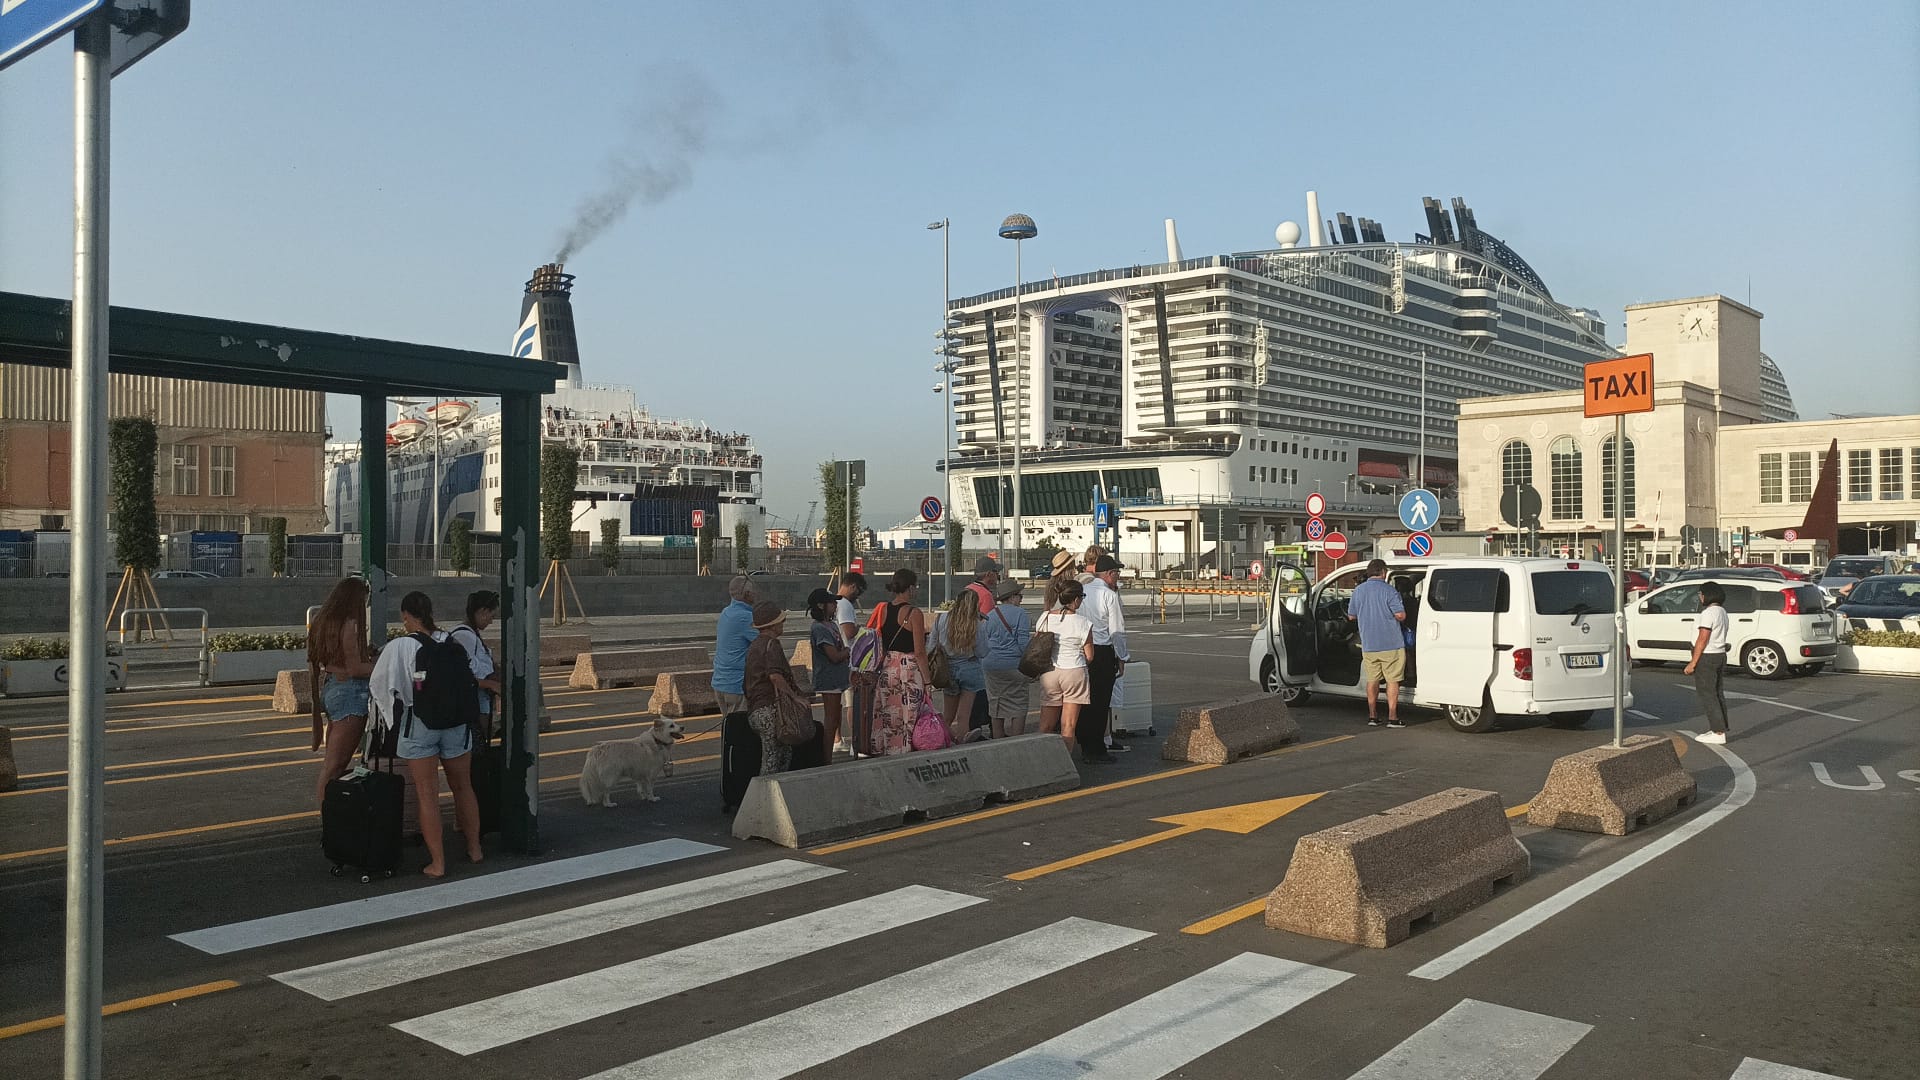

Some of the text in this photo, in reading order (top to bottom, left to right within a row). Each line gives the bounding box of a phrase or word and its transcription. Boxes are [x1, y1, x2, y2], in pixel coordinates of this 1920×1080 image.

[1589, 371, 1647, 401] TAXI
[693, 513, 702, 524] M
[1021, 519, 1037, 528] MSC
[1076, 518, 1095, 527] EUR
